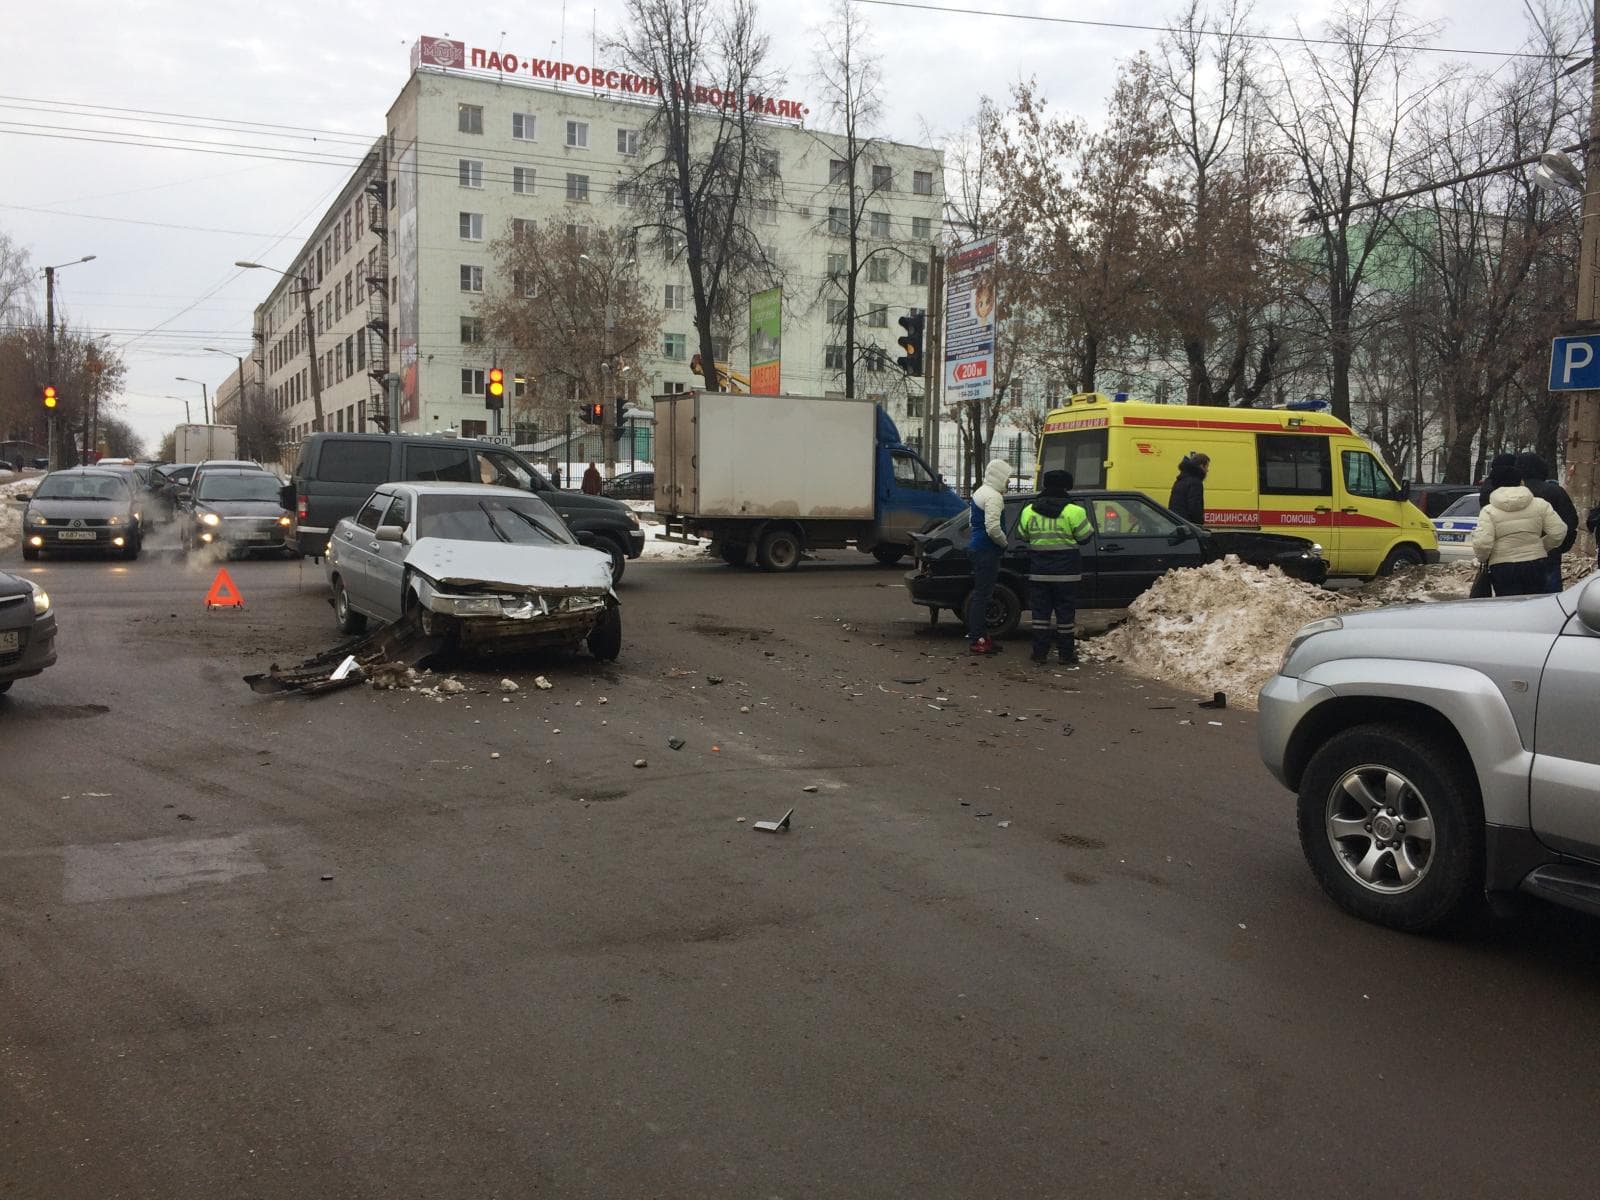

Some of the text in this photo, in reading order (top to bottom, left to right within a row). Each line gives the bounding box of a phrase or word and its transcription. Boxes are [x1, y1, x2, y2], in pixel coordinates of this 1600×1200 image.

[471, 48, 518, 73] ПАО
[748, 93, 803, 119] МАЯК
[1564, 342, 1593, 383] P
[962, 363, 976, 378] 200
[1049, 417, 1106, 431] РЕАНИМАЦИЯ
[481, 437, 508, 445] СТОП
[1029, 516, 1064, 531] ДПС
[1204, 512, 1317, 524] ЕДИЦИНСКАЯ ПОМОЩЬ
